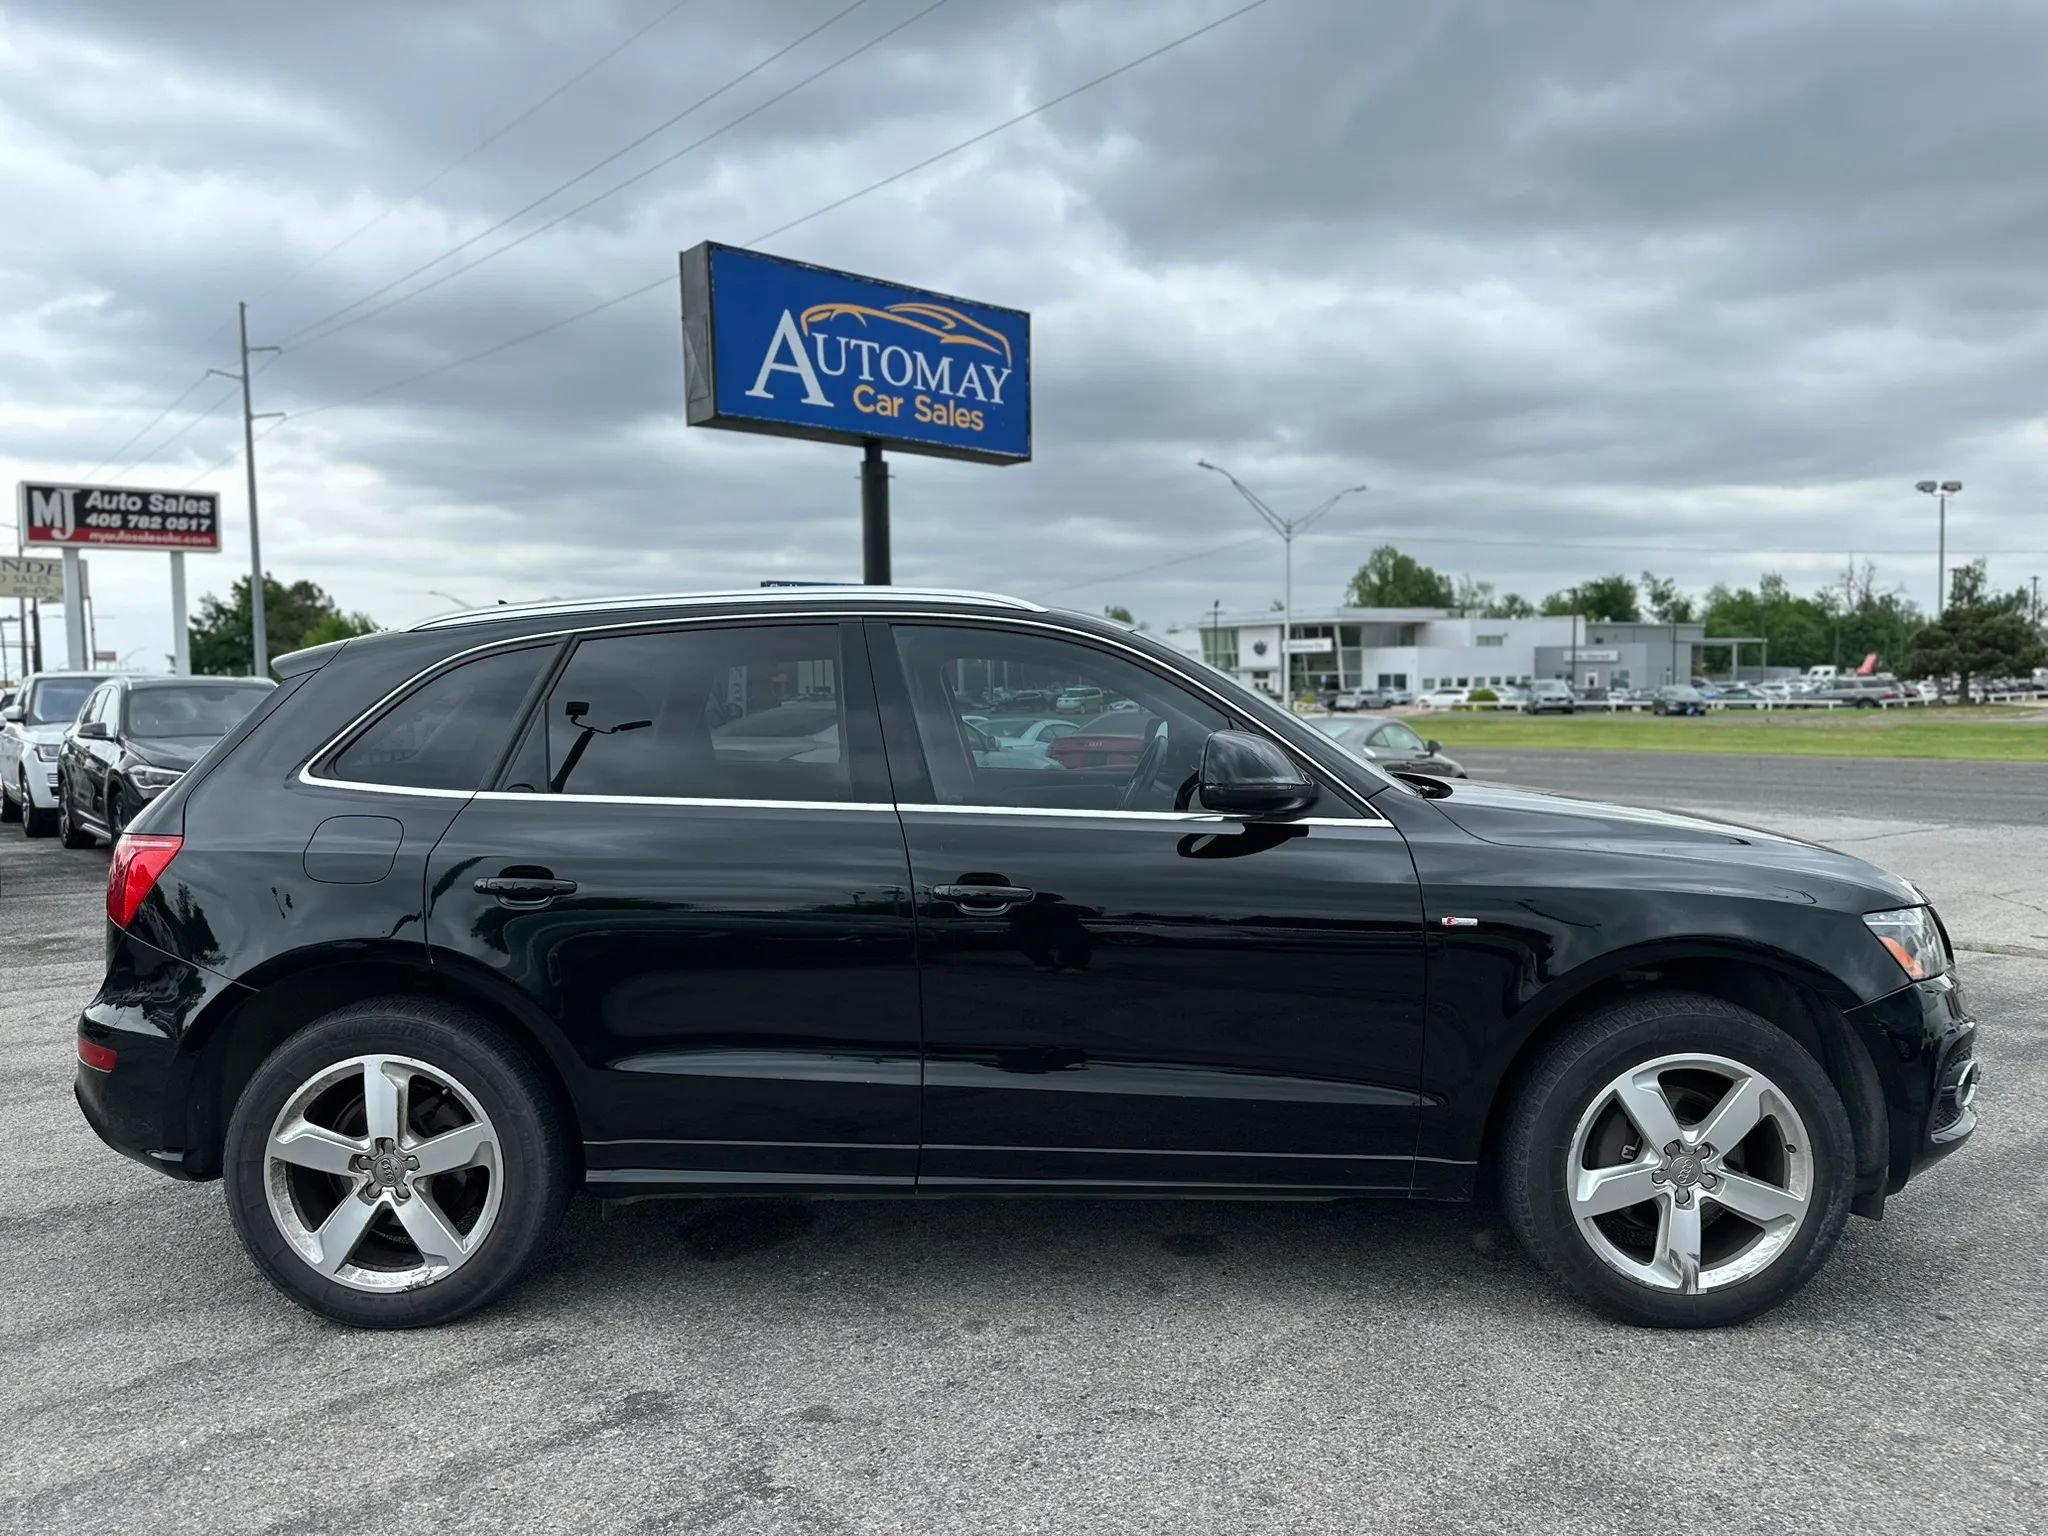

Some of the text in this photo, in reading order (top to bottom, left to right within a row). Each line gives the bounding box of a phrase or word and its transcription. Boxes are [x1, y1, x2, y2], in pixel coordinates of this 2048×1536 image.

[745, 309, 1012, 407] AUTOMAY
[853, 384, 985, 432] Car Sales
[31, 488, 80, 540] MJ
[85, 490, 212, 515] Auto Sales
[85, 512, 211, 532] 405 782 0517
